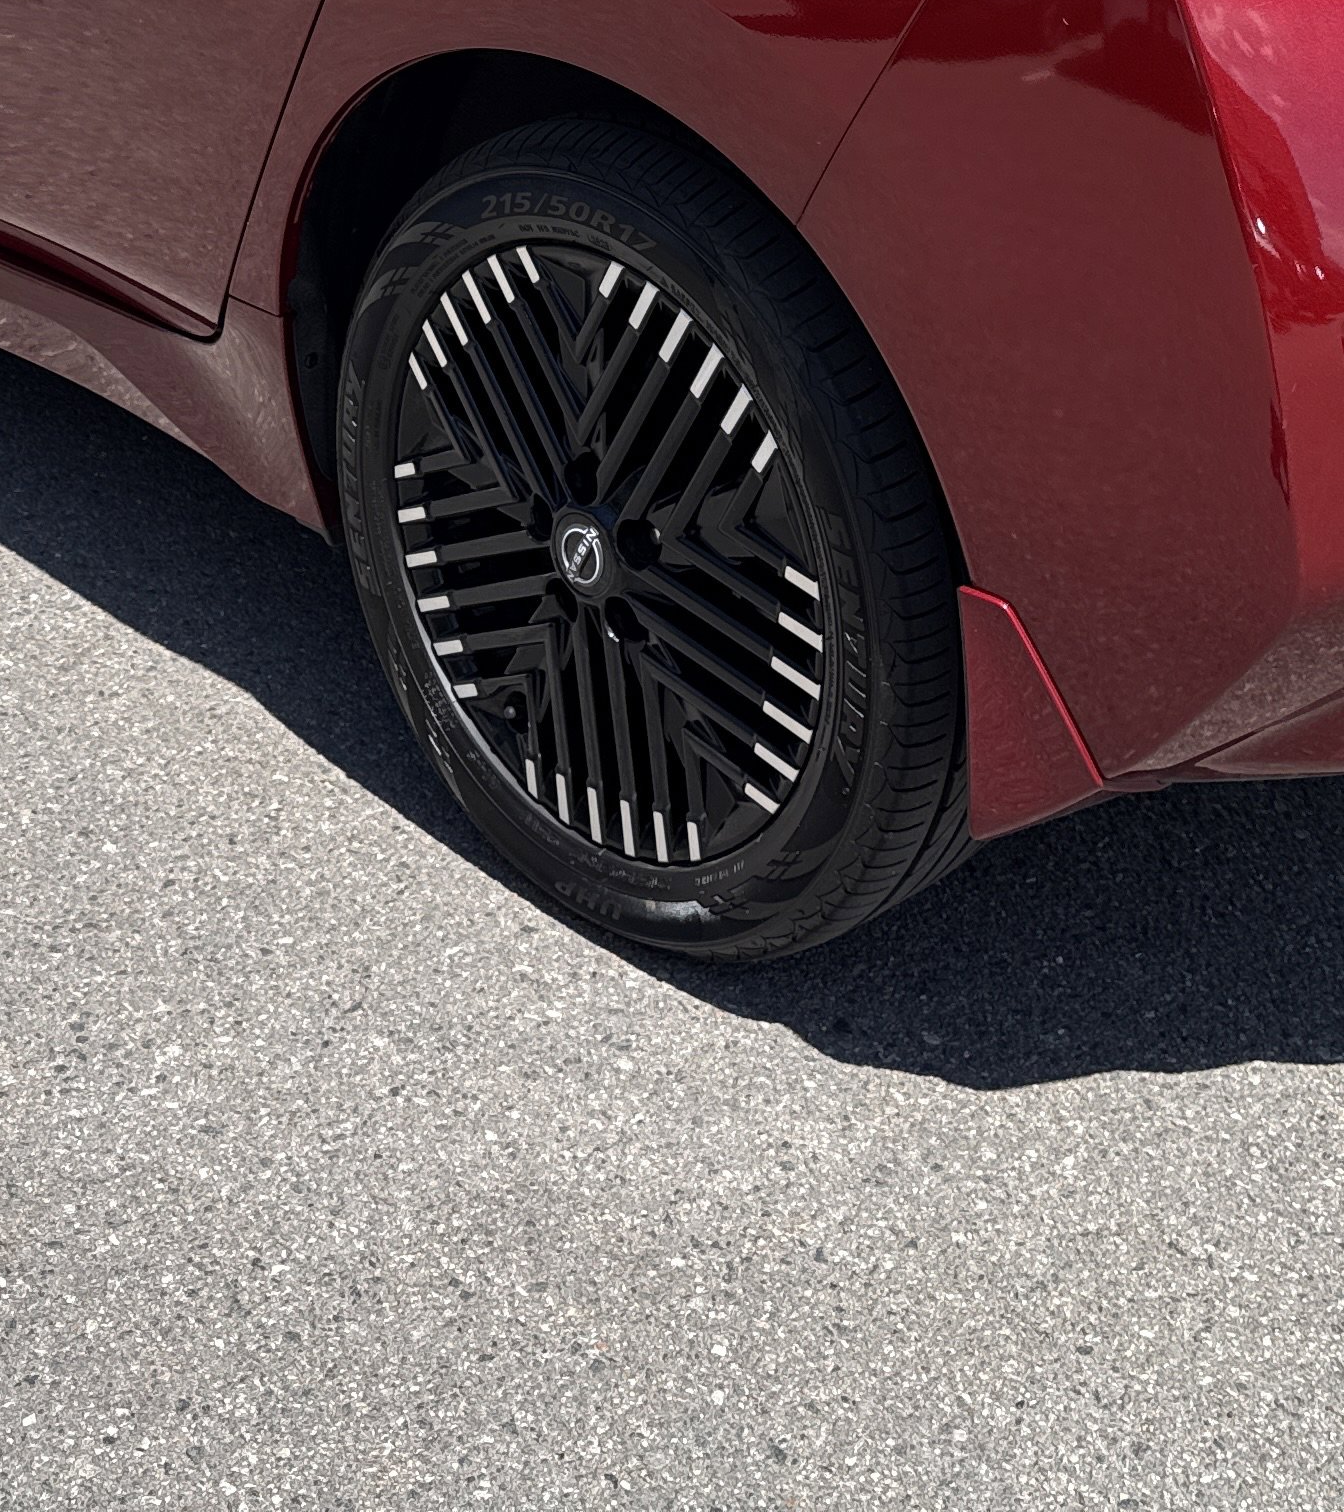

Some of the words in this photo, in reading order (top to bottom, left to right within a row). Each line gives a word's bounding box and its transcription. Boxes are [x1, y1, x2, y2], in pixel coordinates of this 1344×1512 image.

[480, 191, 658, 252] 215/50R17
[341, 359, 382, 598] SENTURY
[566, 525, 600, 584] NISSAN
[816, 506, 868, 788] SENTURY
